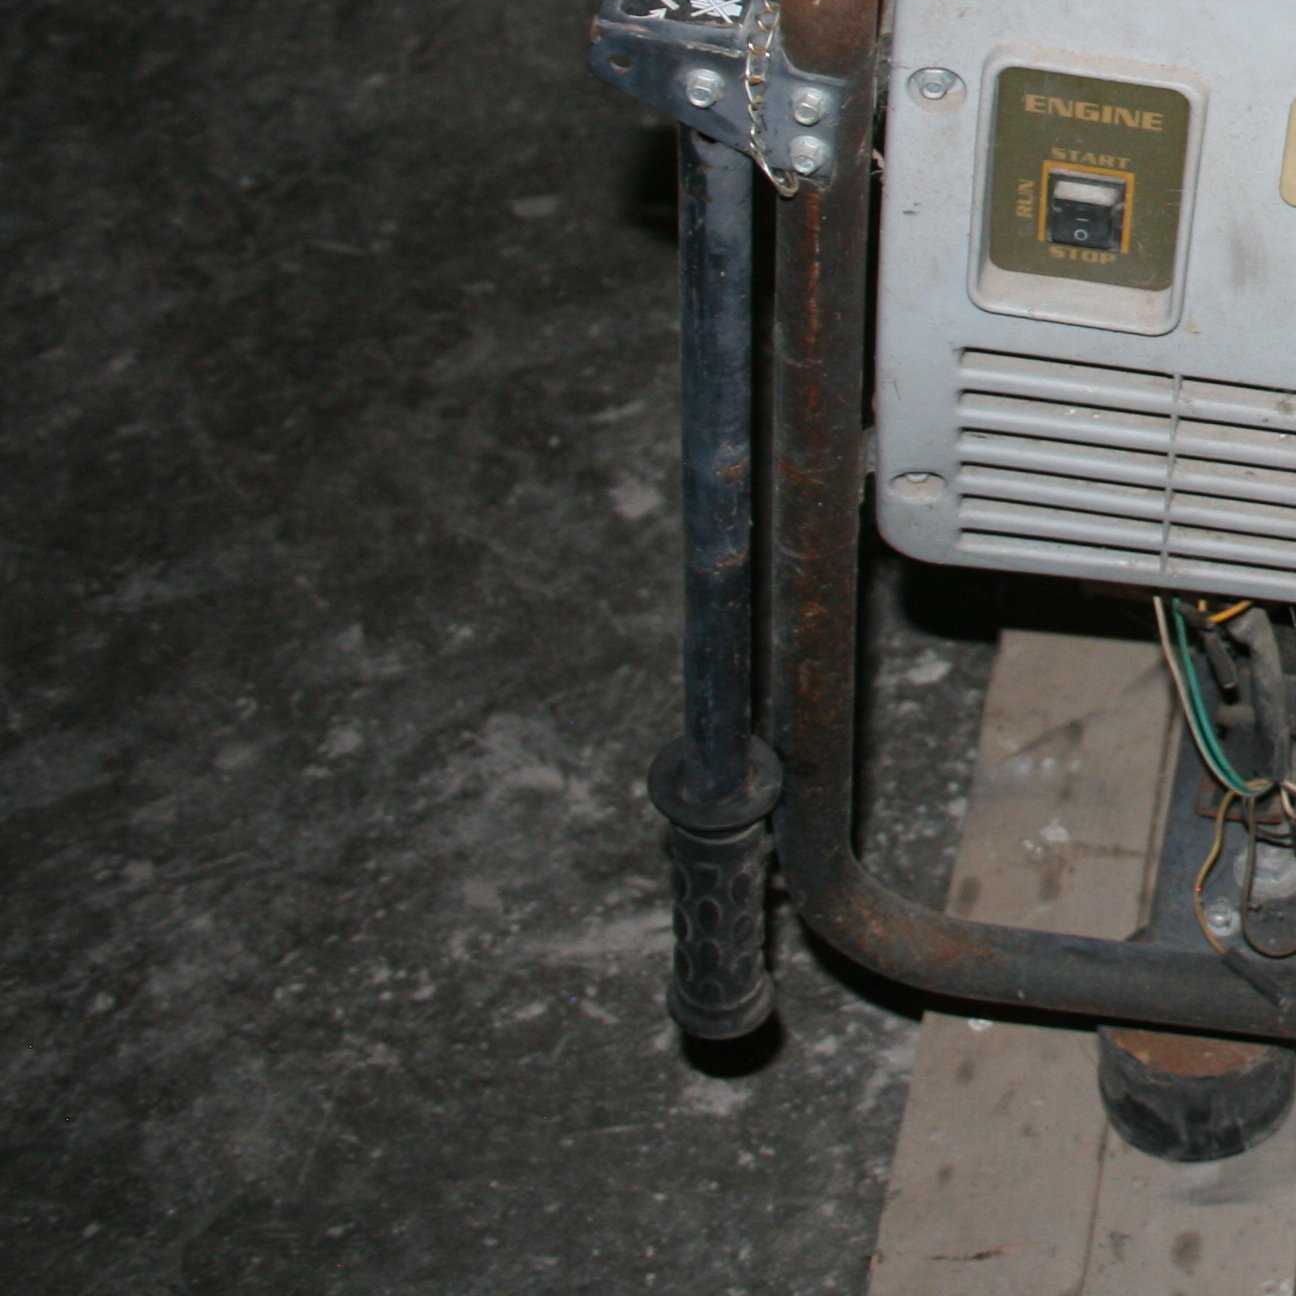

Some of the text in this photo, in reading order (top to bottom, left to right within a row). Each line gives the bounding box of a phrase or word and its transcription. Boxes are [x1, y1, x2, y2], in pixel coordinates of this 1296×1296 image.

[1023, 94, 1164, 132] ENGINE
[1050, 147, 1132, 170] START
[1015, 179, 1035, 220] RUN
[1049, 246, 1117, 266] STOP
